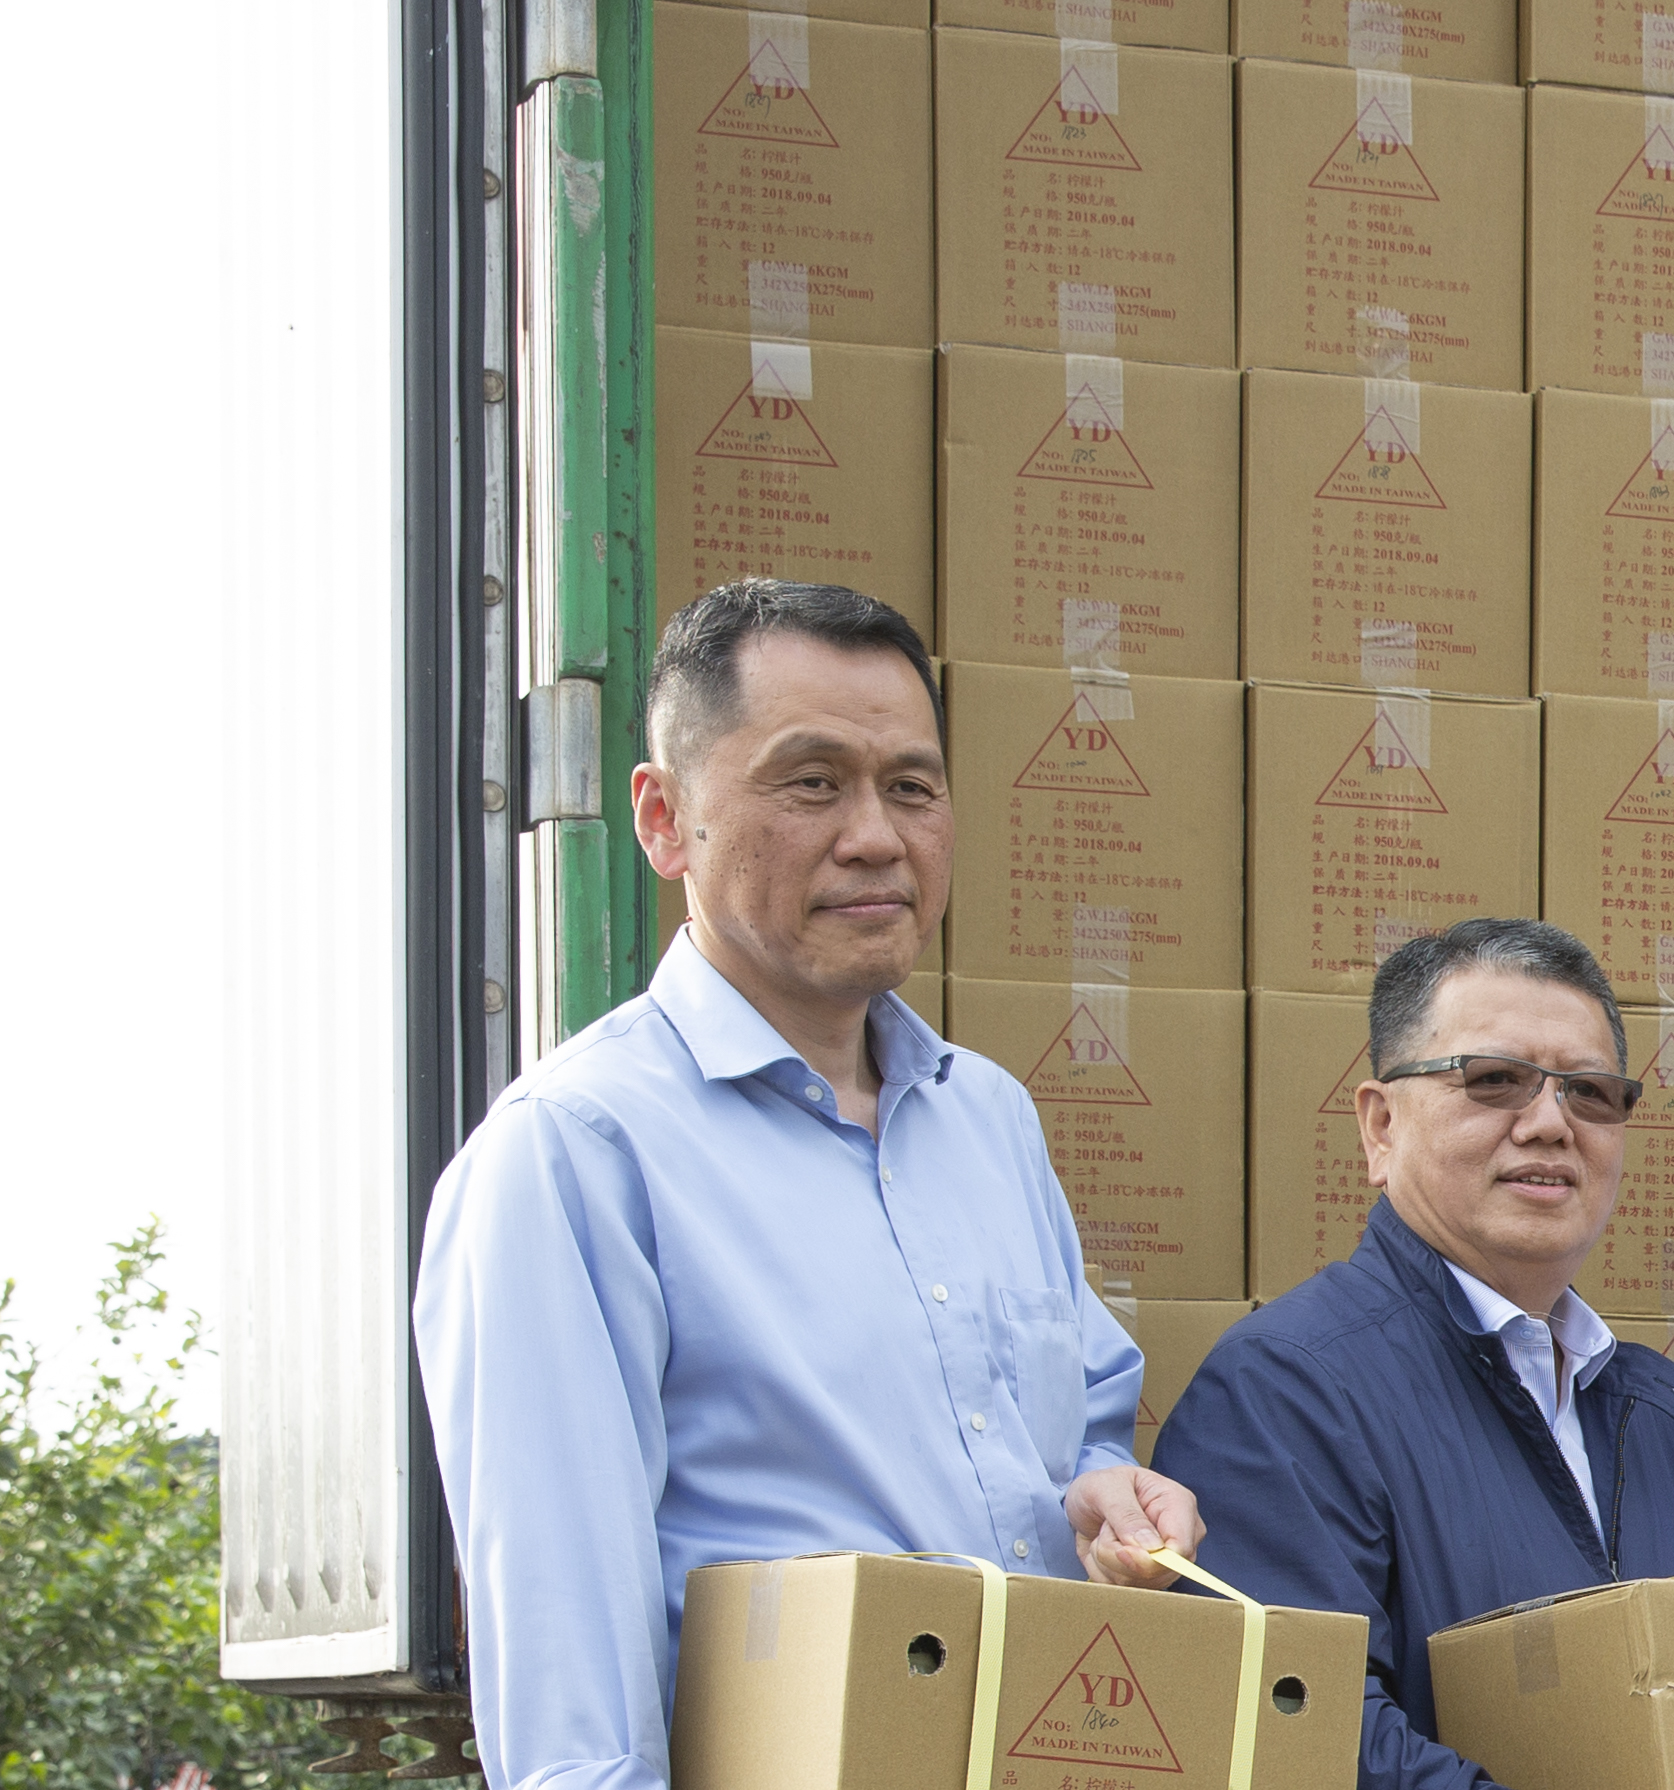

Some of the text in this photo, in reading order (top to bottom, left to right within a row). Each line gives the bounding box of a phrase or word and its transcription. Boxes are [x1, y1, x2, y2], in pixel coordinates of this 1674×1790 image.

[1054, 100, 1099, 125] YD
[762, 186, 834, 206] 2018.09.04
[1068, 210, 1137, 227] 2018.09.04
[1363, 439, 1406, 464] YD
[1374, 547, 1441, 565] 2018.09.04
[1063, 727, 1107, 752] YD
[1075, 837, 1144, 853] 2018.09.04
[1079, 1672, 1134, 1708] YD
[1032, 1735, 1163, 1758] MADE IN TAIWAN
